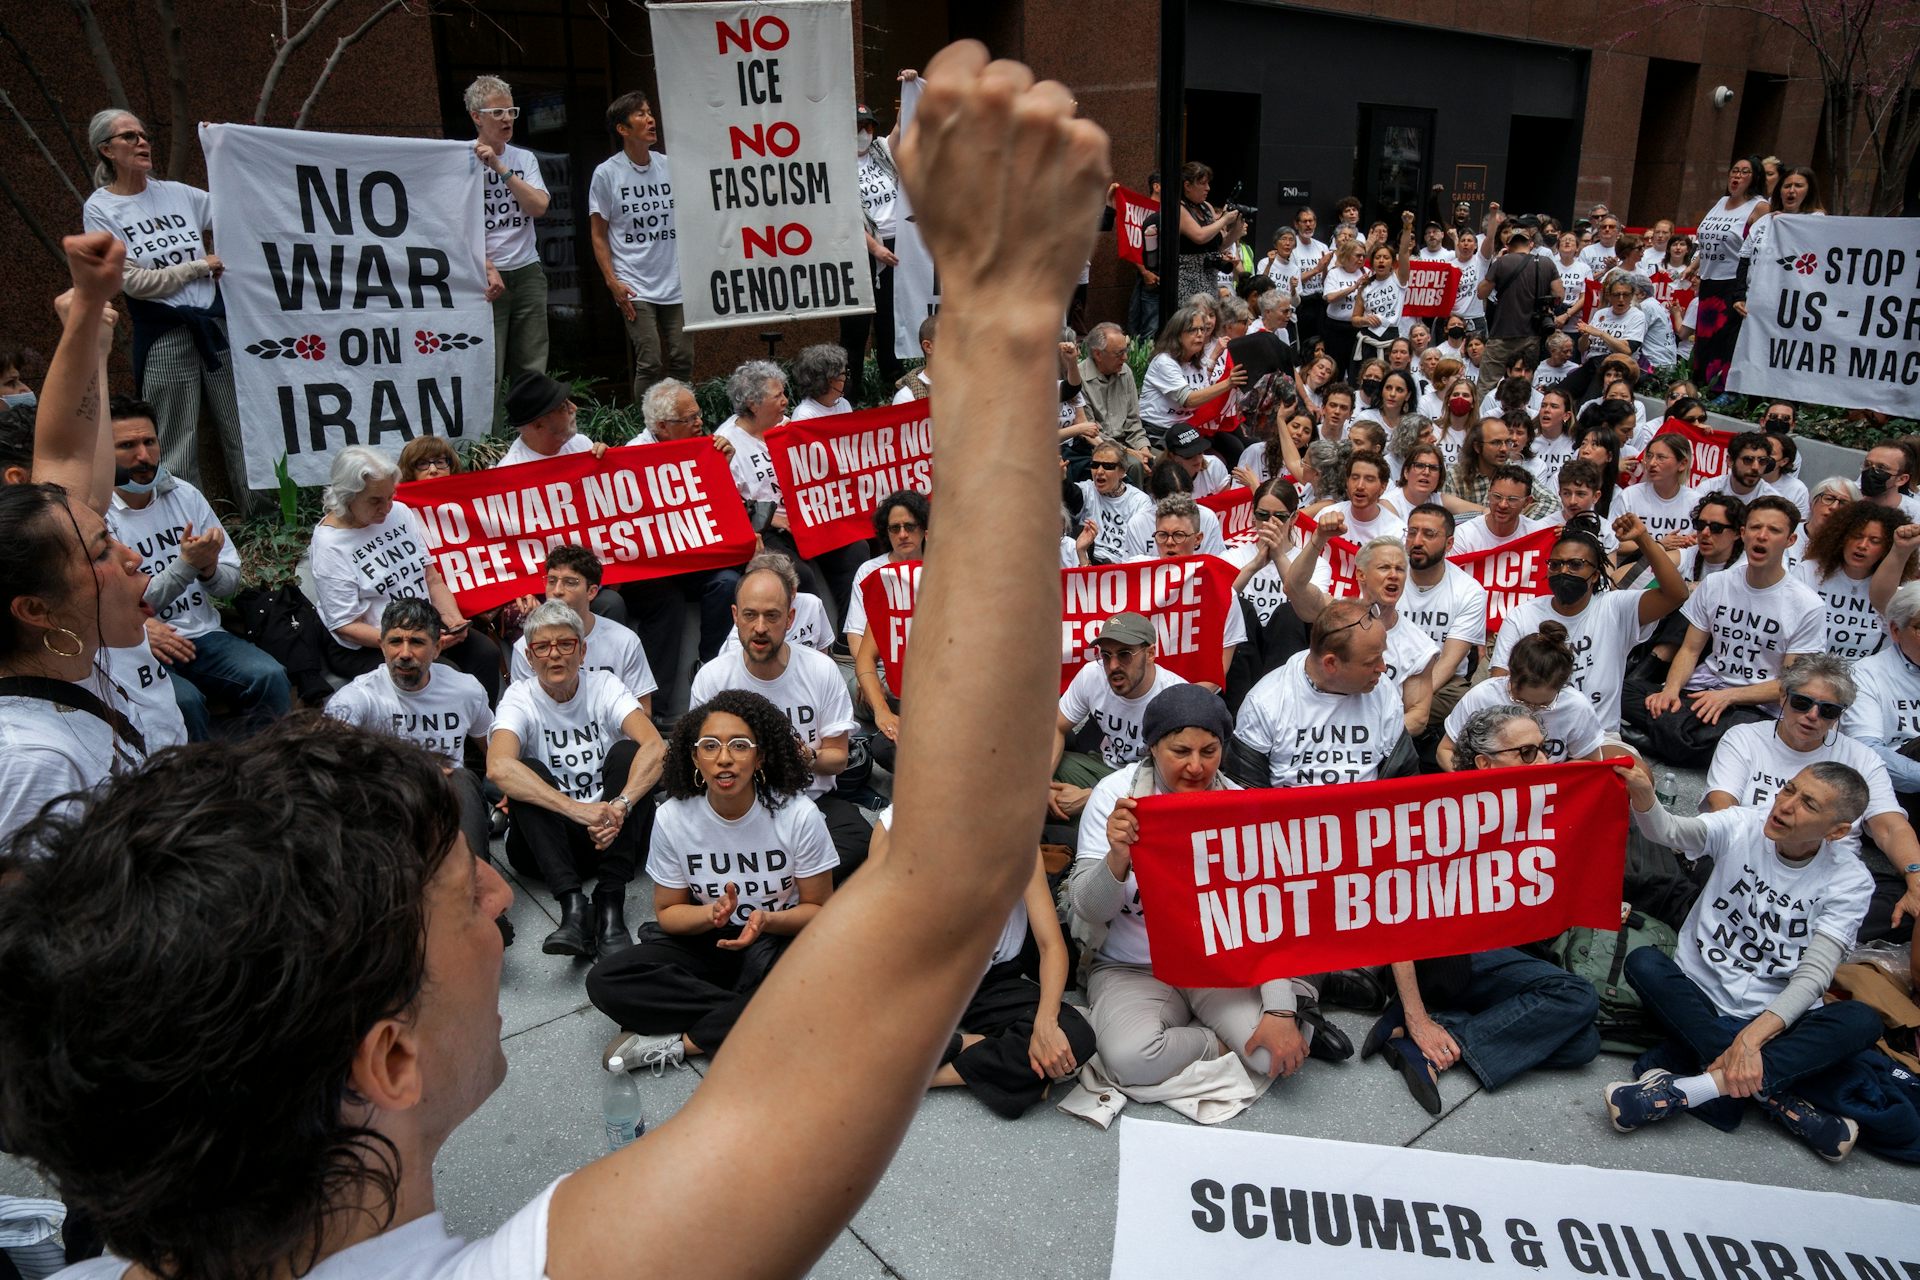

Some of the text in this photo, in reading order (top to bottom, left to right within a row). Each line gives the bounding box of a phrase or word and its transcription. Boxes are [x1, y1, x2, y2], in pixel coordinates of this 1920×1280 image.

[715, 16, 790, 54] NO
[737, 58, 782, 106] ICE
[729, 121, 800, 160] NO
[621, 182, 671, 200] FUND
[710, 162, 831, 211] FASCISM
[863, 190, 898, 209] OMBS
[1452, 193, 1485, 201] GARDENS
[1464, 182, 1477, 190] THE
[295, 164, 409, 238] NO
[622, 199, 674, 214] PEOPLE
[123, 214, 187, 242] FUND
[485, 214, 530, 230] OMBS
[625, 229, 676, 243] BOMBS
[633, 214, 669, 229] NOT
[1701, 222, 1731, 231] FUND
[132, 231, 200, 259] PEOPLE
[742, 223, 812, 259] NO
[153, 247, 197, 270] NOT
[1825, 247, 1906, 287] STOP
[261, 242, 455, 311] WAR
[710, 261, 859, 315] GENOCIDE
[1269, 273, 1289, 281] FUN
[1408, 269, 1449, 288] EOPLE
[1404, 287, 1445, 306] OMBS
[1777, 288, 1827, 332] US
[339, 327, 402, 367] ON
[1769, 338, 1837, 374] WAR
[277, 376, 464, 455] IRAN
[787, 441, 829, 486] NO
[830, 428, 896, 475] WAR
[1540, 454, 1572, 463] UND
[1696, 442, 1719, 475] NO
[411, 502, 471, 550] NO
[472, 482, 580, 539] WAR
[581, 469, 644, 521] NO
[645, 459, 707, 507] ICE
[796, 479, 856, 528] FREE
[137, 526, 185, 558] UND
[352, 524, 408, 564] JEWS SAY
[361, 540, 417, 580] FUND
[1483, 550, 1540, 588] ICE
[1066, 561, 1205, 615] NO ICE
[1715, 605, 1780, 635] FUND
[1826, 612, 1878, 630] EOPLE
[1713, 624, 1777, 651] PEOPLE
[1720, 642, 1760, 663] NOT
[392, 712, 460, 733] FUND
[1296, 725, 1370, 746] FUND
[550, 748, 604, 768] EOPL
[1291, 751, 1372, 767] PEOPLE
[1297, 769, 1360, 786] NOT
[1753, 771, 1786, 788] JEW
[1190, 783, 1557, 887] FUND PEOPLE
[686, 849, 787, 876] FUND
[736, 898, 779, 922] OT
[1197, 845, 1556, 957] NOT BOMBS
[1713, 922, 1788, 975] NOT
[1190, 1177, 1493, 1264] SCHUMER
[1504, 1218, 1545, 1269] &
